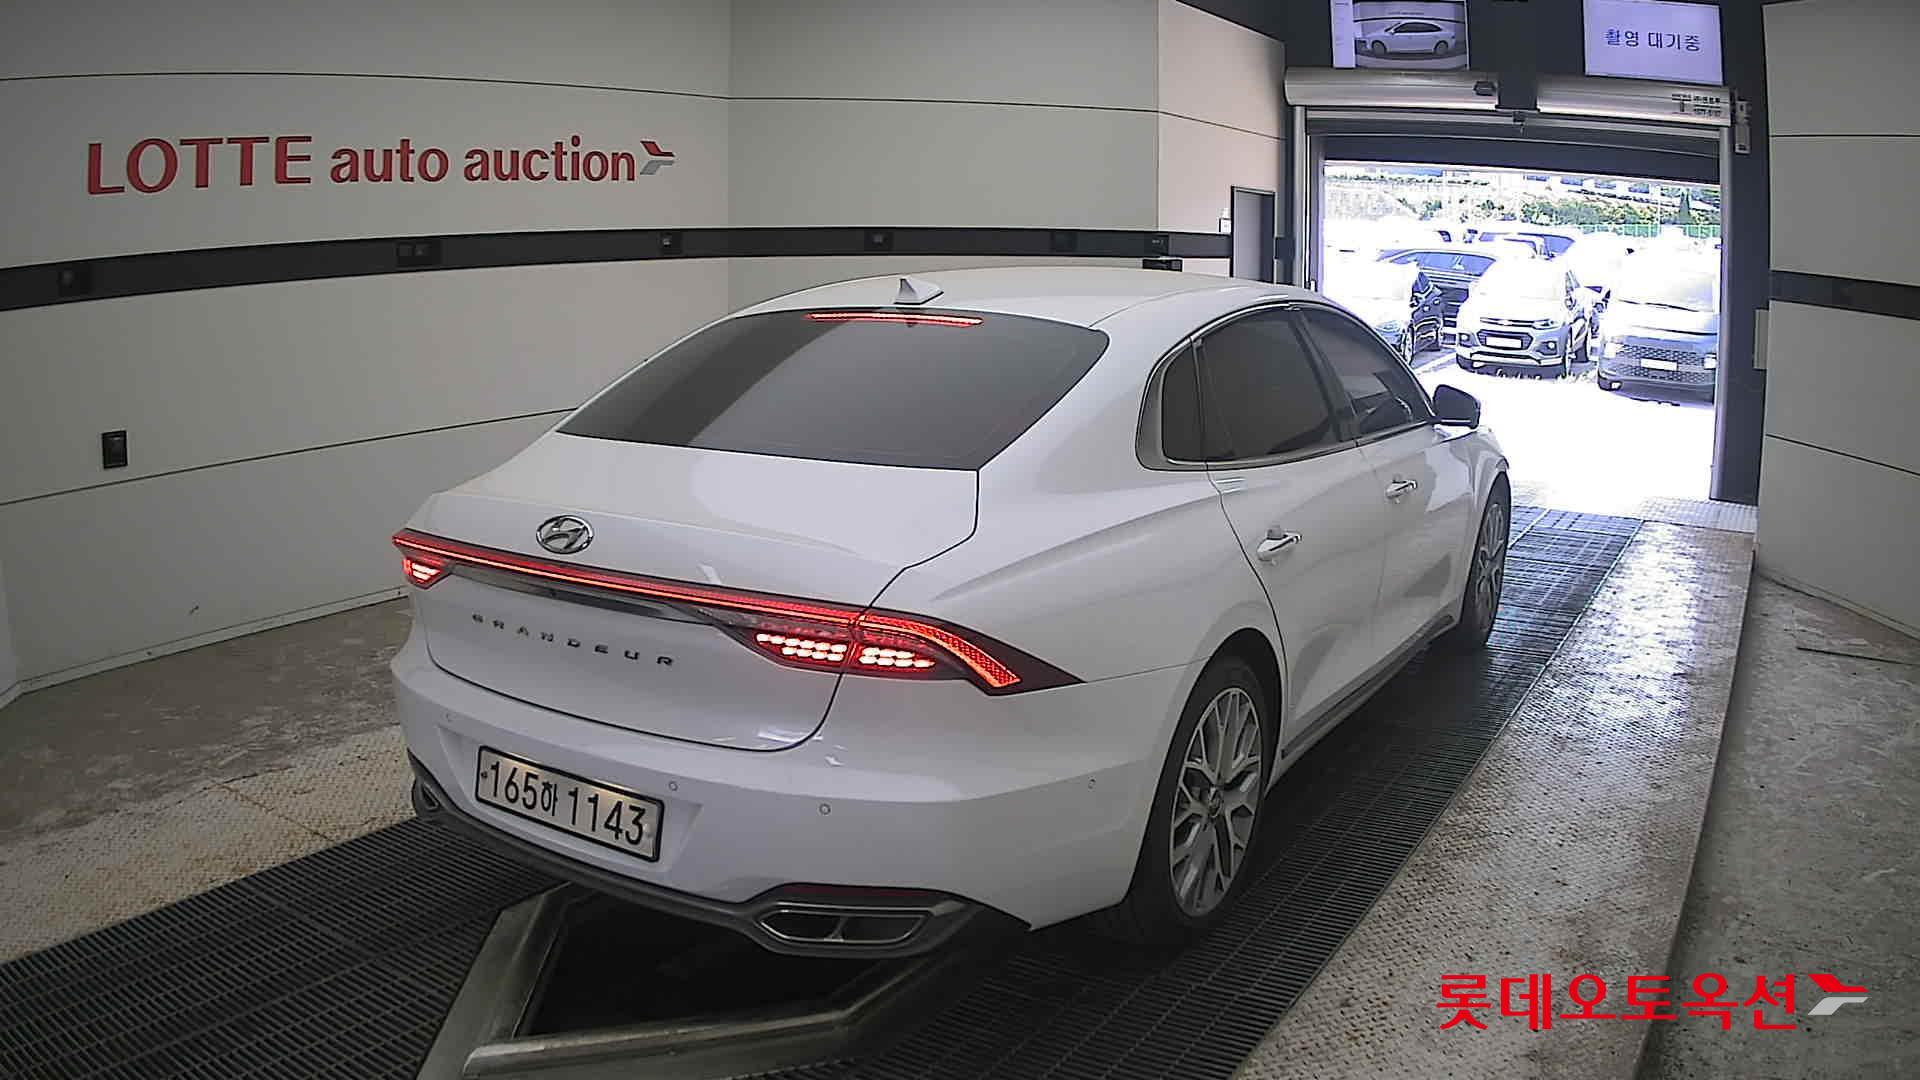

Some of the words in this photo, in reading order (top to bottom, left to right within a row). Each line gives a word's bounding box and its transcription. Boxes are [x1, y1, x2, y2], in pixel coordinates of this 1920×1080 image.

[1604, 28, 1640, 48] 촬영
[1647, 31, 1701, 52] 대기중
[88, 136, 312, 195] LOTTE
[331, 138, 449, 184] auto
[464, 135, 636, 182] auction
[471, 613, 675, 667] GRANDEUR
[490, 761, 558, 817] 165하
[568, 786, 646, 846] 1143
